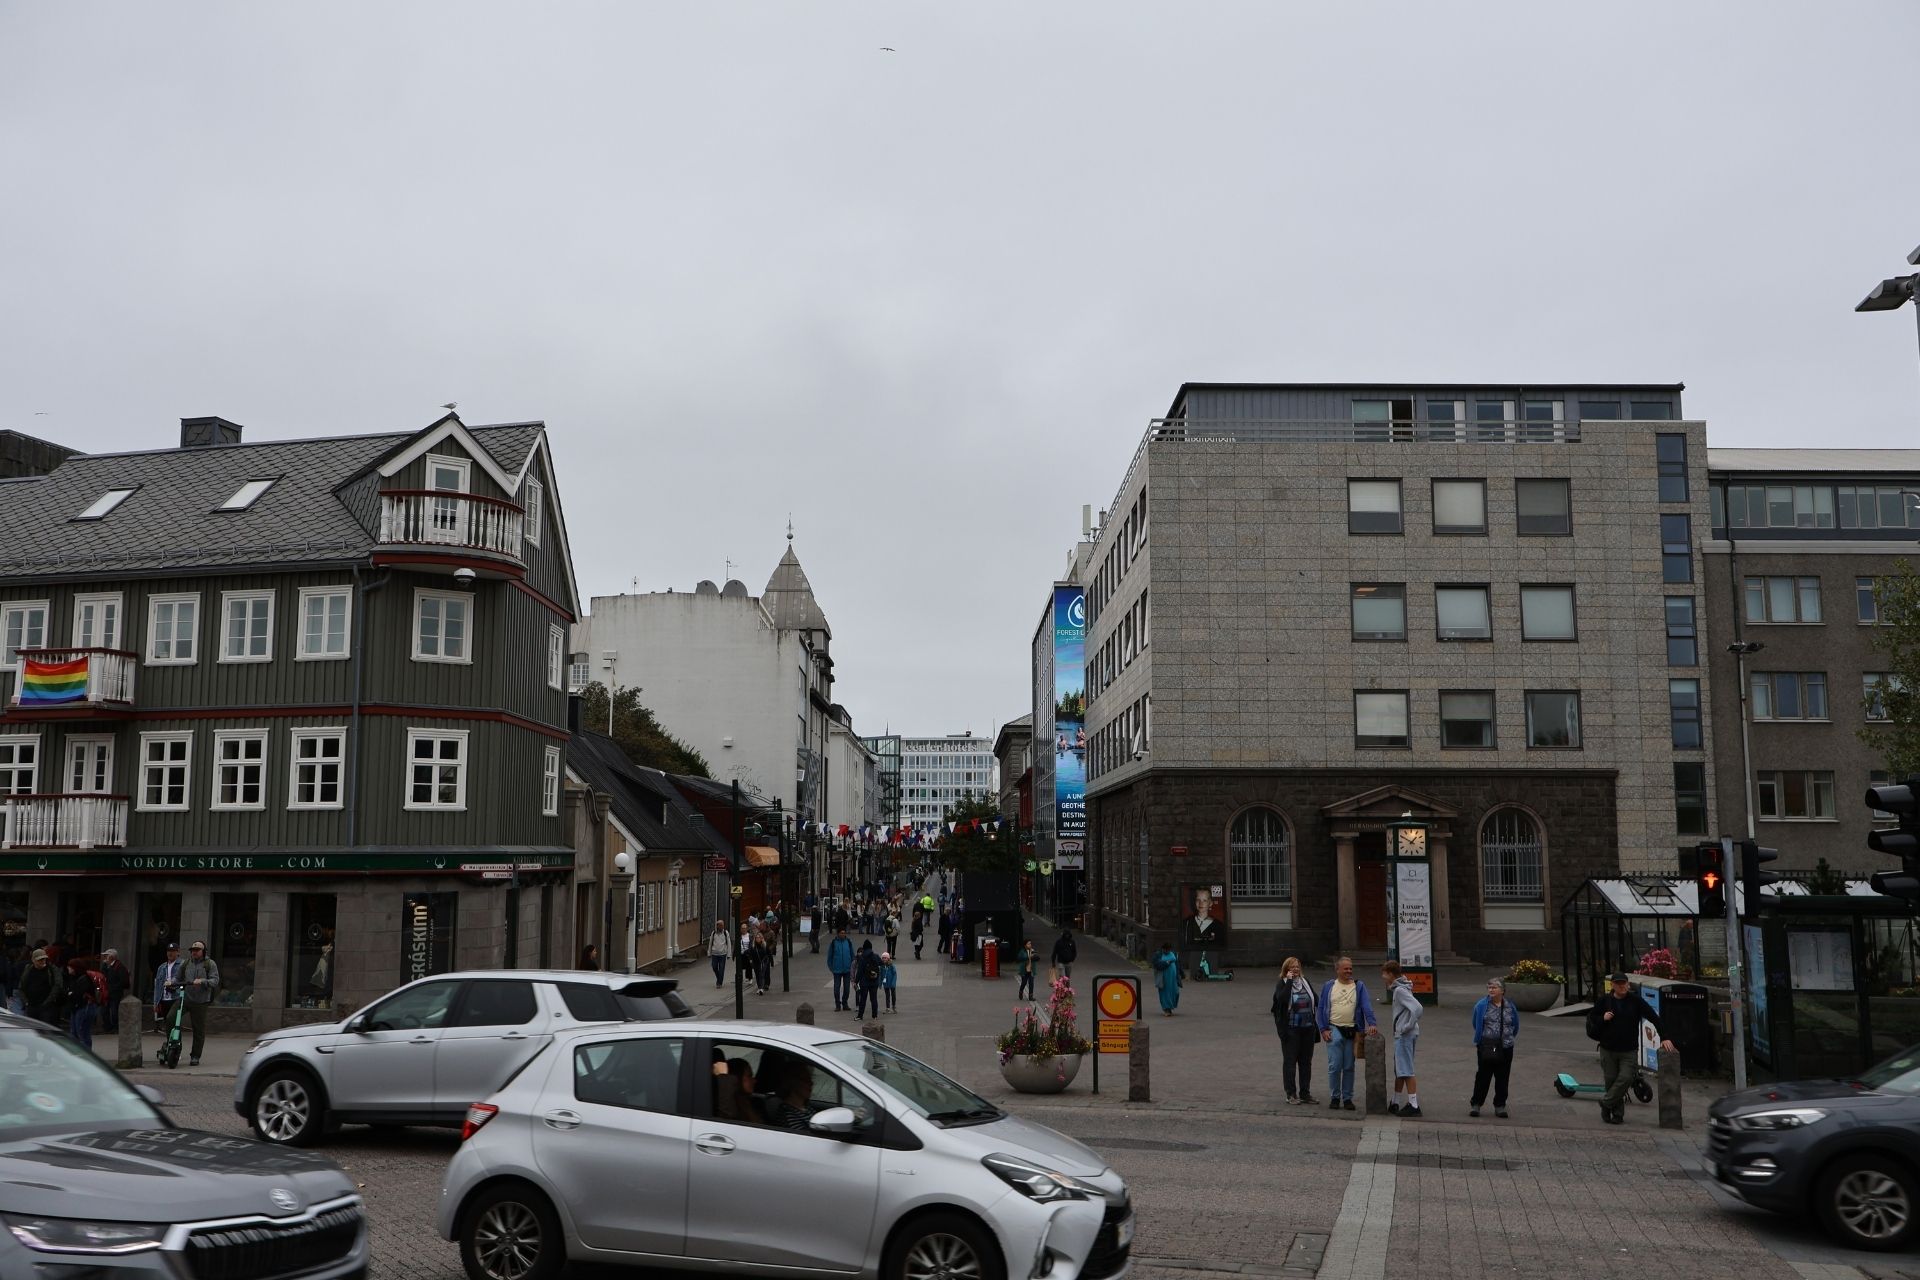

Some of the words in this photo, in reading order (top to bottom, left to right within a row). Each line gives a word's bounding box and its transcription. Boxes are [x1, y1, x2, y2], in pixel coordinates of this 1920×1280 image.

[1058, 849, 1084, 857] SBARRO
[120, 856, 188, 869] NORDIC
[196, 856, 254, 869] STORE
[280, 856, 326, 869] .COM
[1402, 903, 1425, 911] Luxury
[1399, 910, 1429, 918] shopping
[1407, 918, 1428, 926] dining
